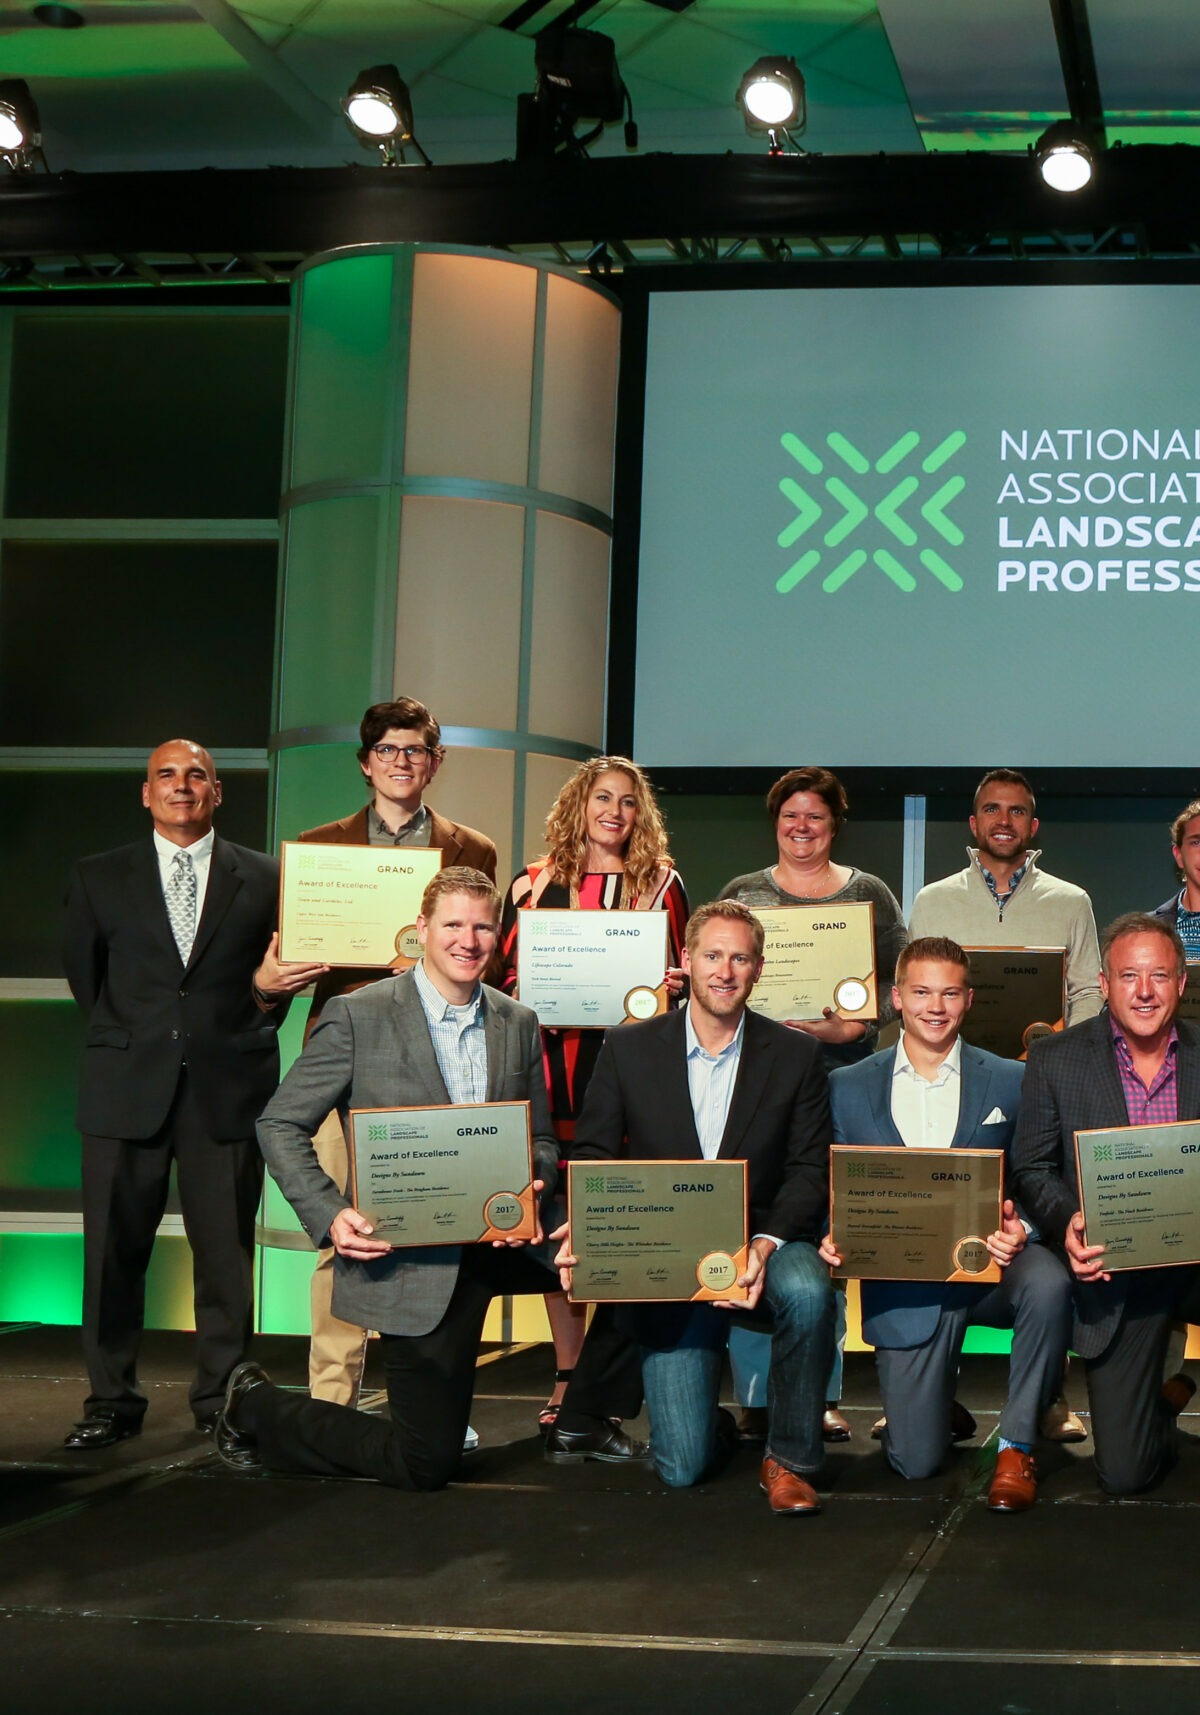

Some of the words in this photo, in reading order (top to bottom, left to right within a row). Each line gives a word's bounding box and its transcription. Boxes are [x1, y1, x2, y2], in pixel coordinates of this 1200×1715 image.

[378, 866, 414, 874] GRAND
[336, 882, 378, 890] Excellence
[812, 922, 846, 931] GRAND
[1004, 967, 1038, 975] GRAND
[456, 1126, 498, 1136] GRAND
[370, 1152, 399, 1160] Award
[412, 1150, 459, 1158] Excellence
[931, 1173, 971, 1181] GRAND
[1096, 1173, 1124, 1182] Award
[1138, 1168, 1184, 1178] Excellence
[673, 1184, 714, 1192] GRAND
[496, 1206, 515, 1214] 2017
